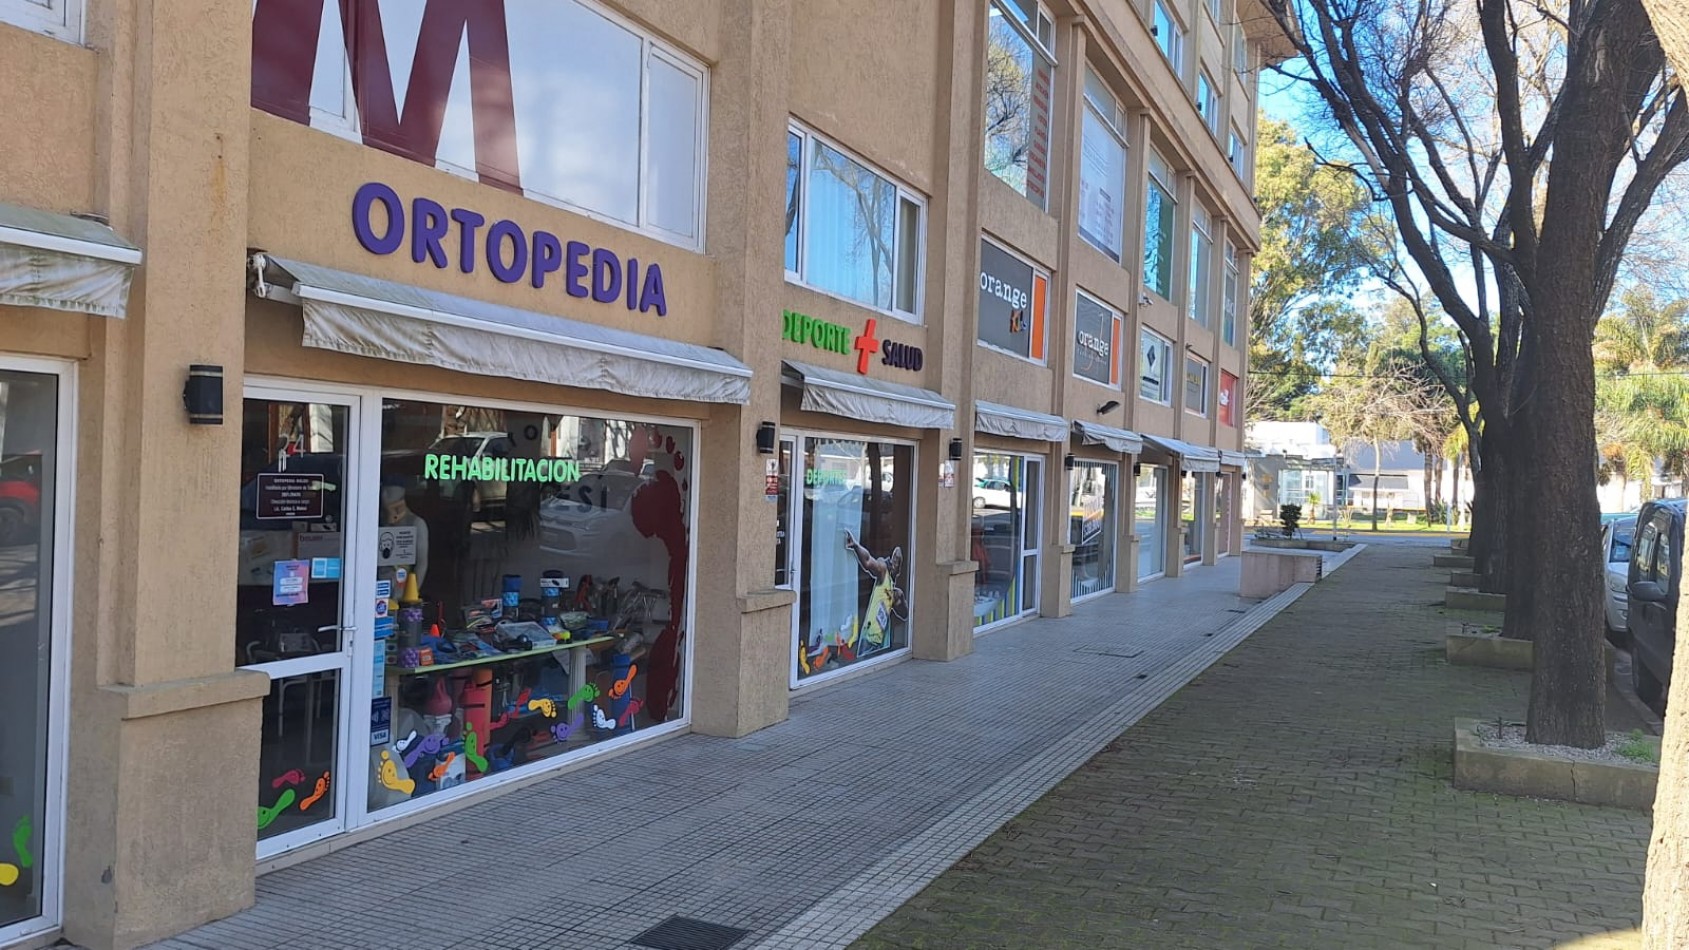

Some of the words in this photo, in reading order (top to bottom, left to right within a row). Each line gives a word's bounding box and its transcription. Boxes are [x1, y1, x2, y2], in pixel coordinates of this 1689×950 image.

[352, 181, 668, 317] ORTOPEDIA
[980, 271, 1028, 309] orange
[782, 309, 852, 355] DEPORTE
[881, 339, 924, 372] SALUD
[1077, 330, 1109, 358] orange
[424, 453, 581, 483] REHABILITACION
[373, 730, 387, 741] VISA
